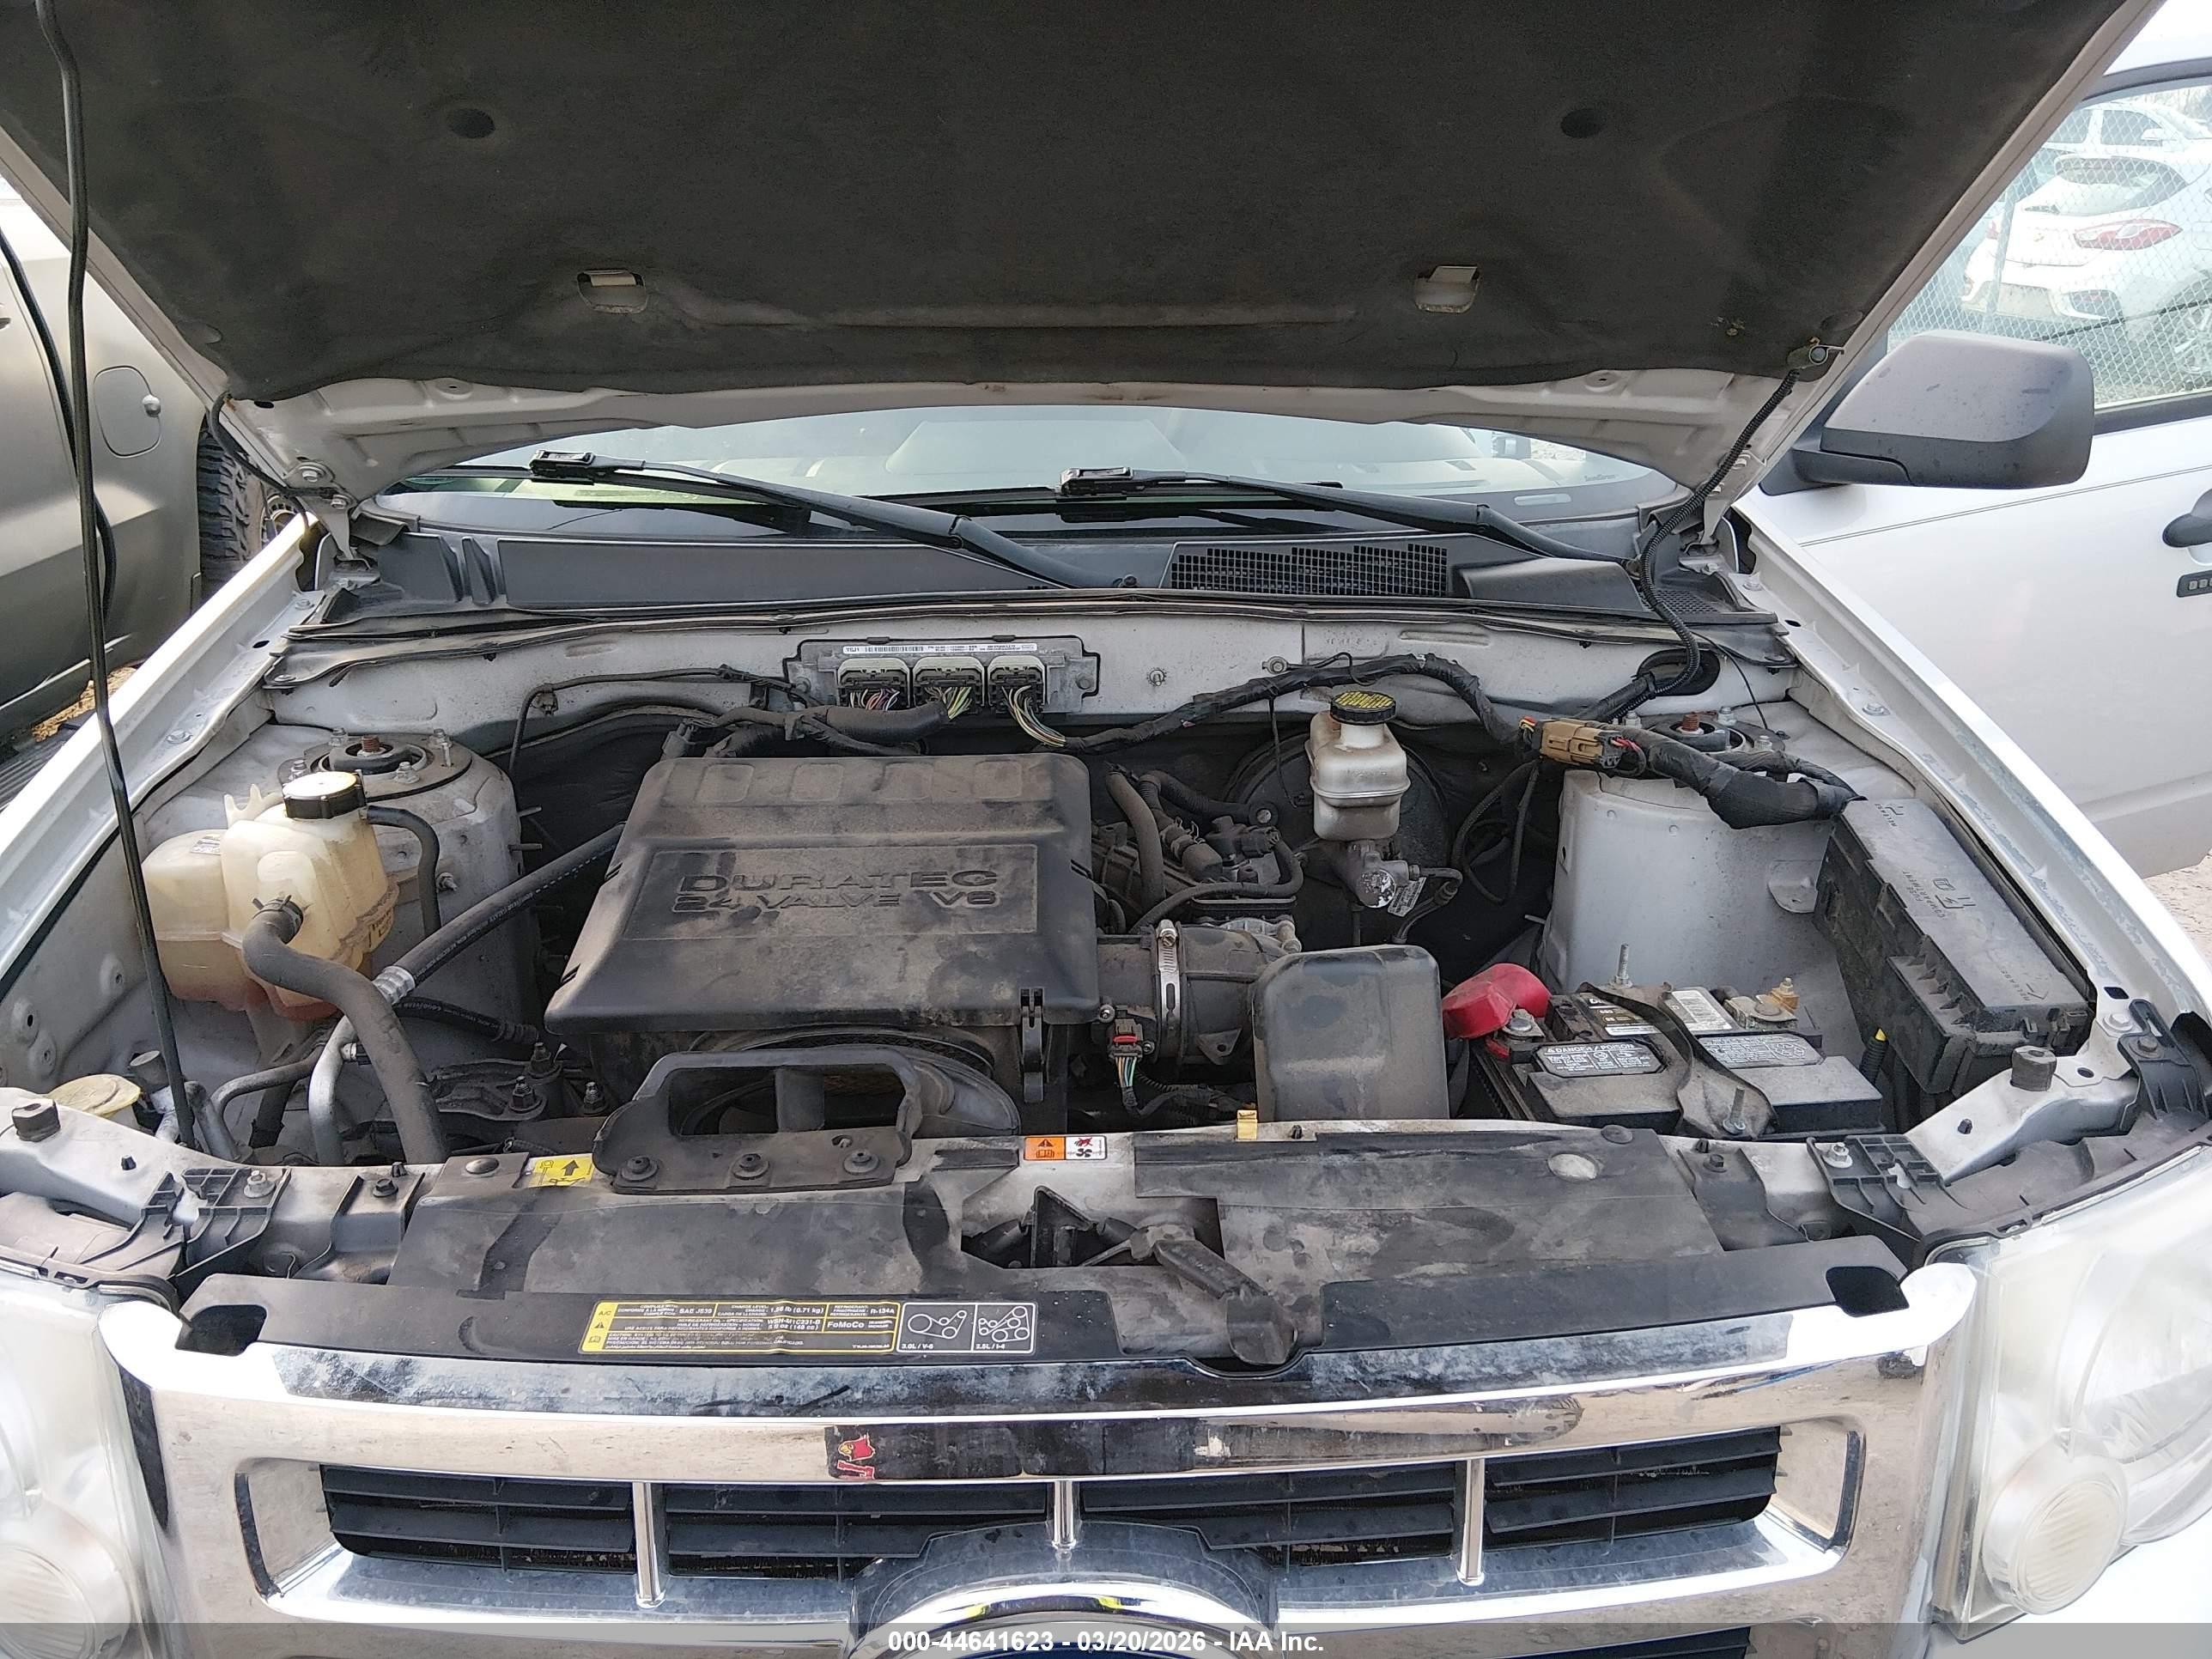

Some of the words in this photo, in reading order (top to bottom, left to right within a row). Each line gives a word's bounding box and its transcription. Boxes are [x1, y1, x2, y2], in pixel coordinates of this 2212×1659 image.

[679, 869, 998, 892] DURATEC
[672, 895, 741, 912] 24
[756, 893, 902, 909] VALVE
[1902, 870, 1946, 918] COMPARTMENT
